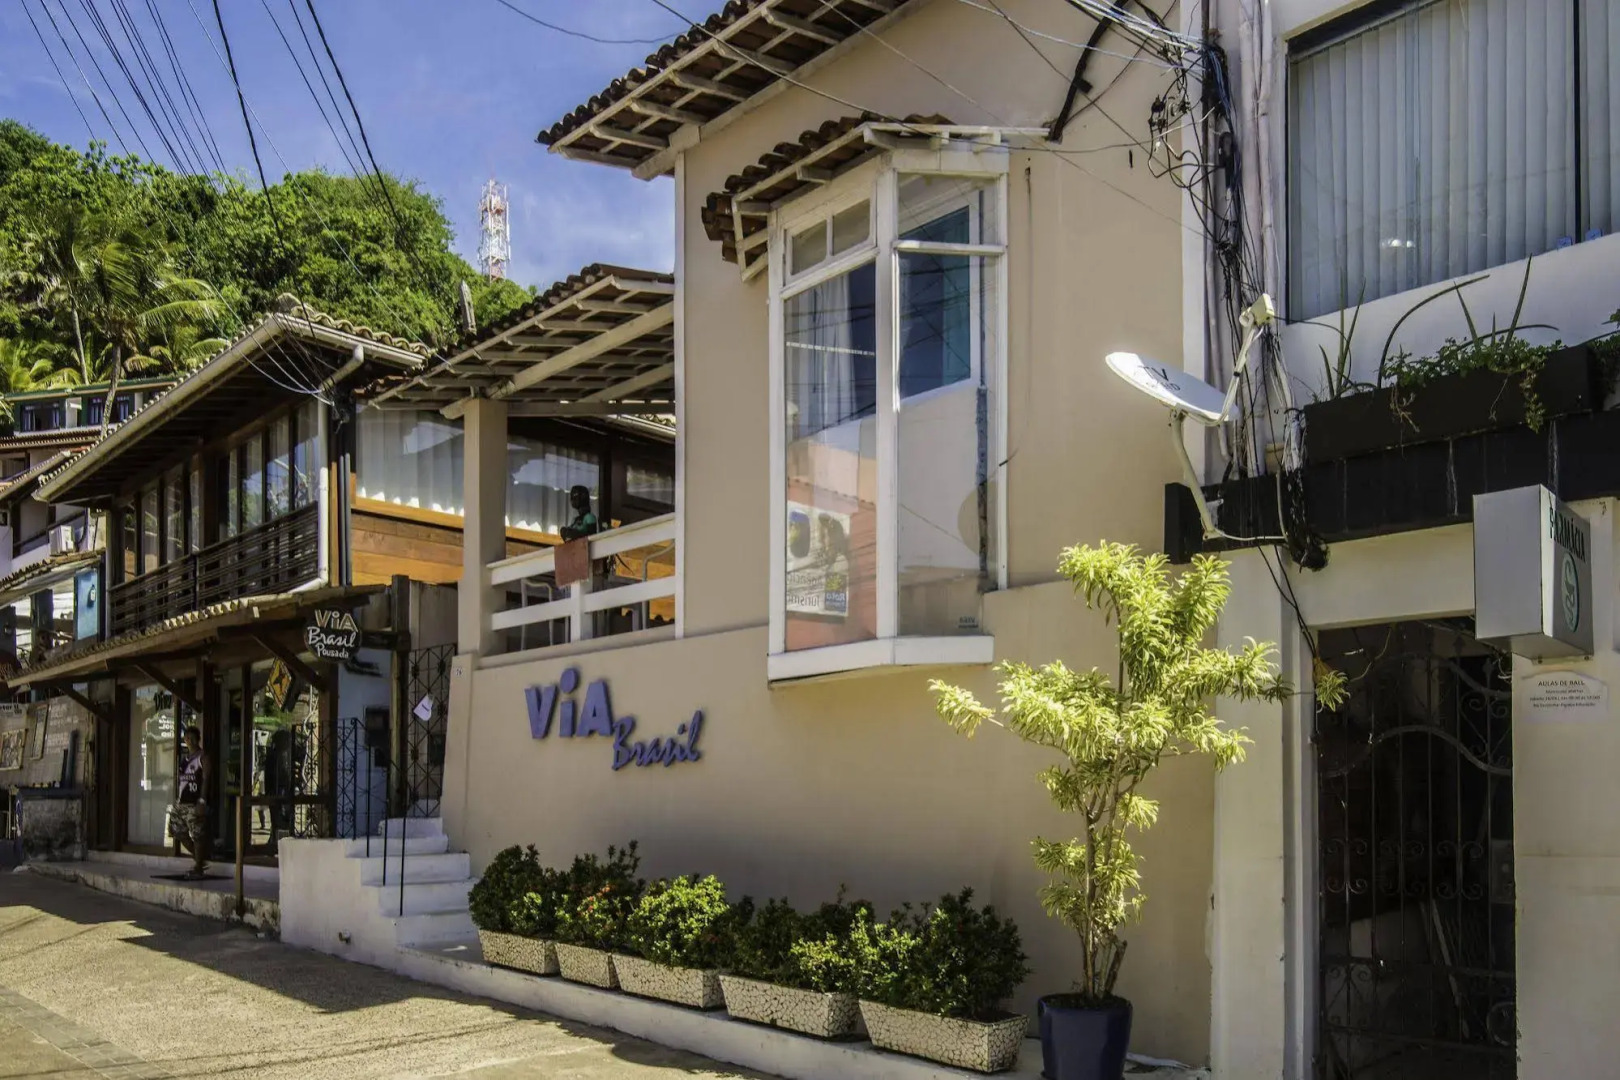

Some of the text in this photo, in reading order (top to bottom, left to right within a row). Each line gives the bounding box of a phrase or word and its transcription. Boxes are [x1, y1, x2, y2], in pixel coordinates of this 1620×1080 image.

[1550, 506, 1586, 563] FARMÁCIA
[307, 626, 357, 648] Brasil
[315, 642, 349, 659] Pousada
[611, 710, 704, 771] Brasil
